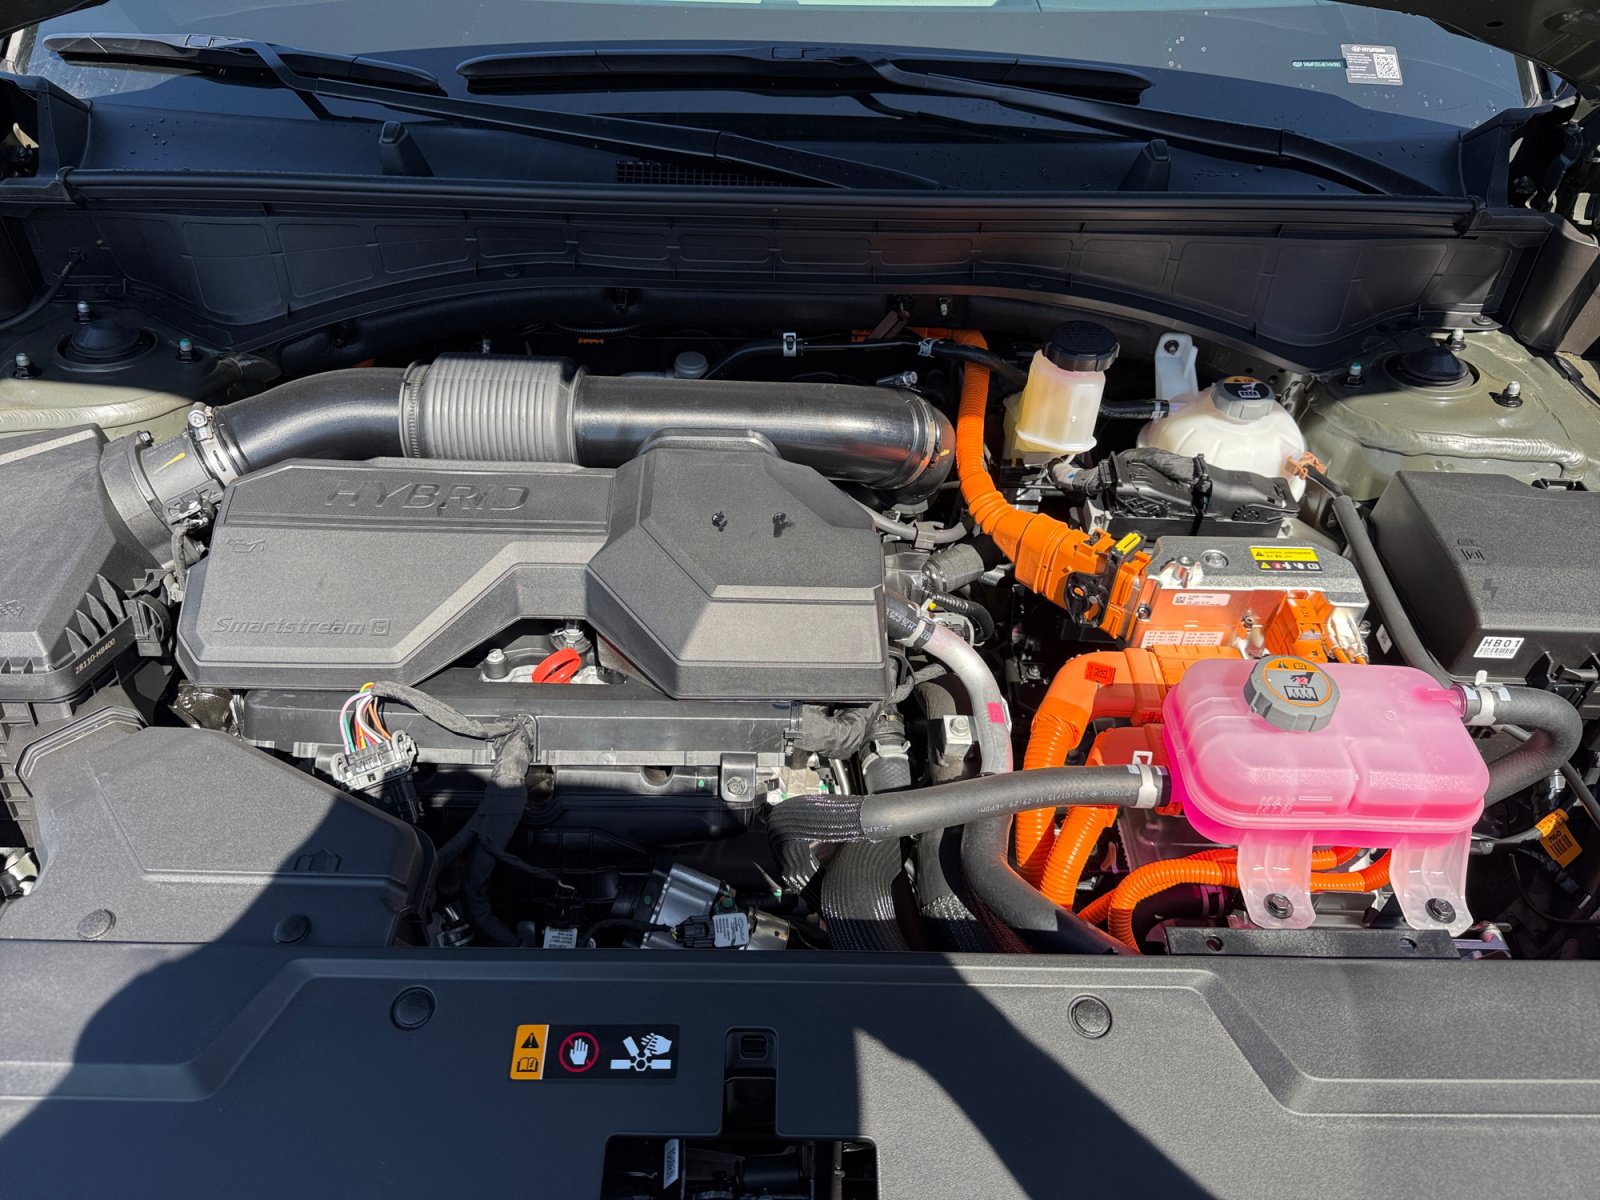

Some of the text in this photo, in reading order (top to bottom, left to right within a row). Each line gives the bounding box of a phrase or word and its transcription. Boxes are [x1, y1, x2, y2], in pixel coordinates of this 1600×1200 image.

[324, 480, 530, 511] HYBRID
[211, 616, 391, 636] Smartstream G
[1482, 638, 1521, 648] HB01
